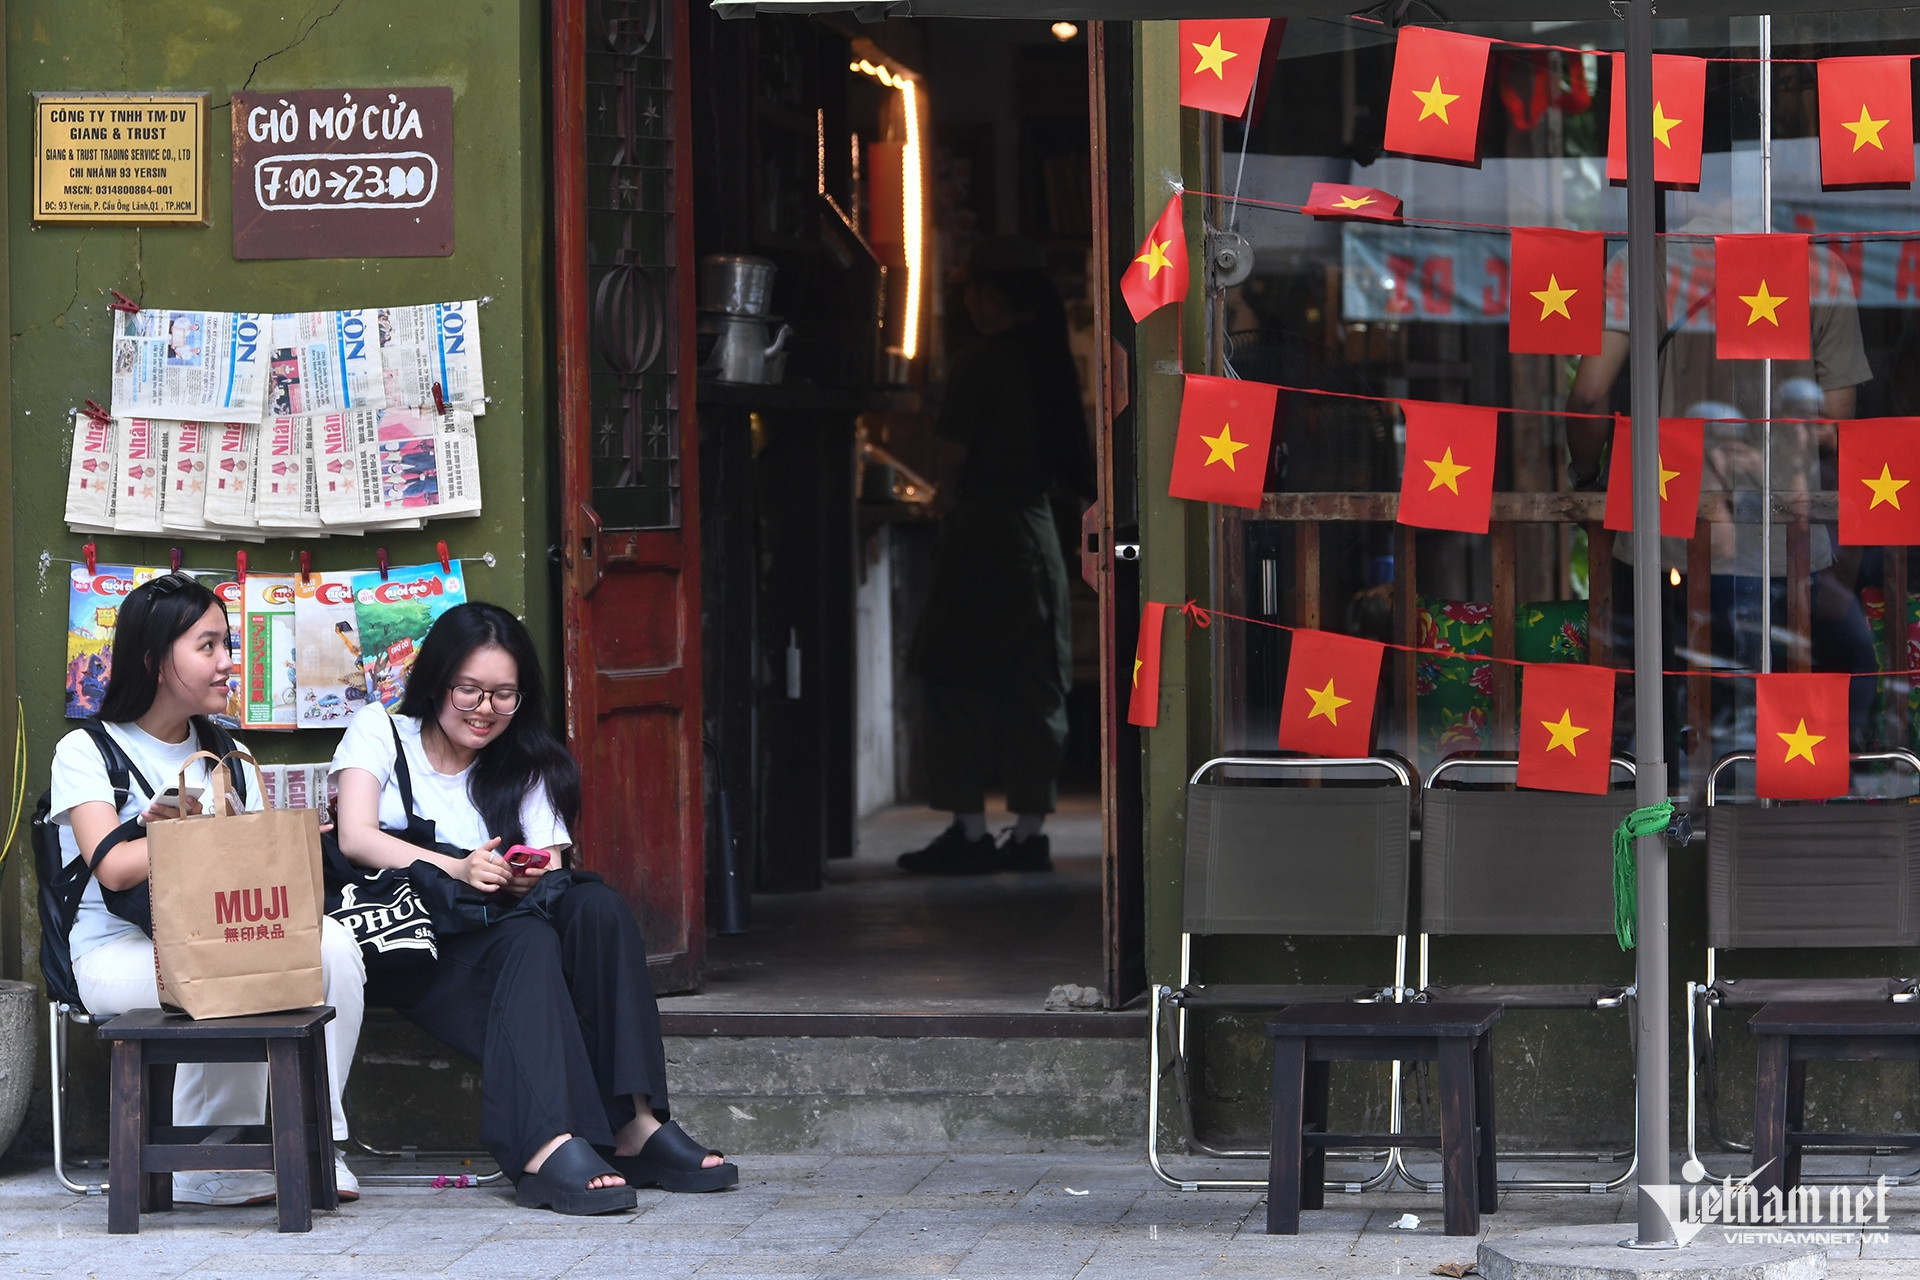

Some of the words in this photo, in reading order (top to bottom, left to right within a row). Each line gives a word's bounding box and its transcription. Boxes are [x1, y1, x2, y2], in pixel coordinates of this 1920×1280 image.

[50, 107, 85, 123] CÔNG
[89, 110, 105, 122] TY
[110, 110, 143, 122] TNHH
[247, 99, 299, 144] GIỜ
[308, 92, 358, 141] MỞ
[362, 93, 423, 140] CỬA
[70, 127, 108, 140] GIANG
[112, 127, 122, 140] &
[127, 127, 167, 140] TRUST
[46, 149, 67, 161] GIANG
[68, 149, 74, 161] &
[77, 149, 98, 161] TRUST
[100, 149, 129, 161] TRADING
[131, 149, 160, 161] SERVICE
[178, 149, 191, 161] LTD
[69, 167, 84, 178] CHI
[119, 167, 131, 178] 93
[134, 167, 167, 178] YERSIN
[63, 185, 93, 195] MSCN:
[263, 166, 321, 200] 7:00
[58, 201, 68, 211] 93
[69, 201, 92, 212] Yersin,
[93, 201, 101, 211] P.
[165, 201, 192, 211] TP.HCM
[84, 418, 103, 454] Nhâ
[178, 421, 198, 454] Nhâ
[214, 885, 290, 925] MUJI
[223, 923, 286, 943] 無印良品
